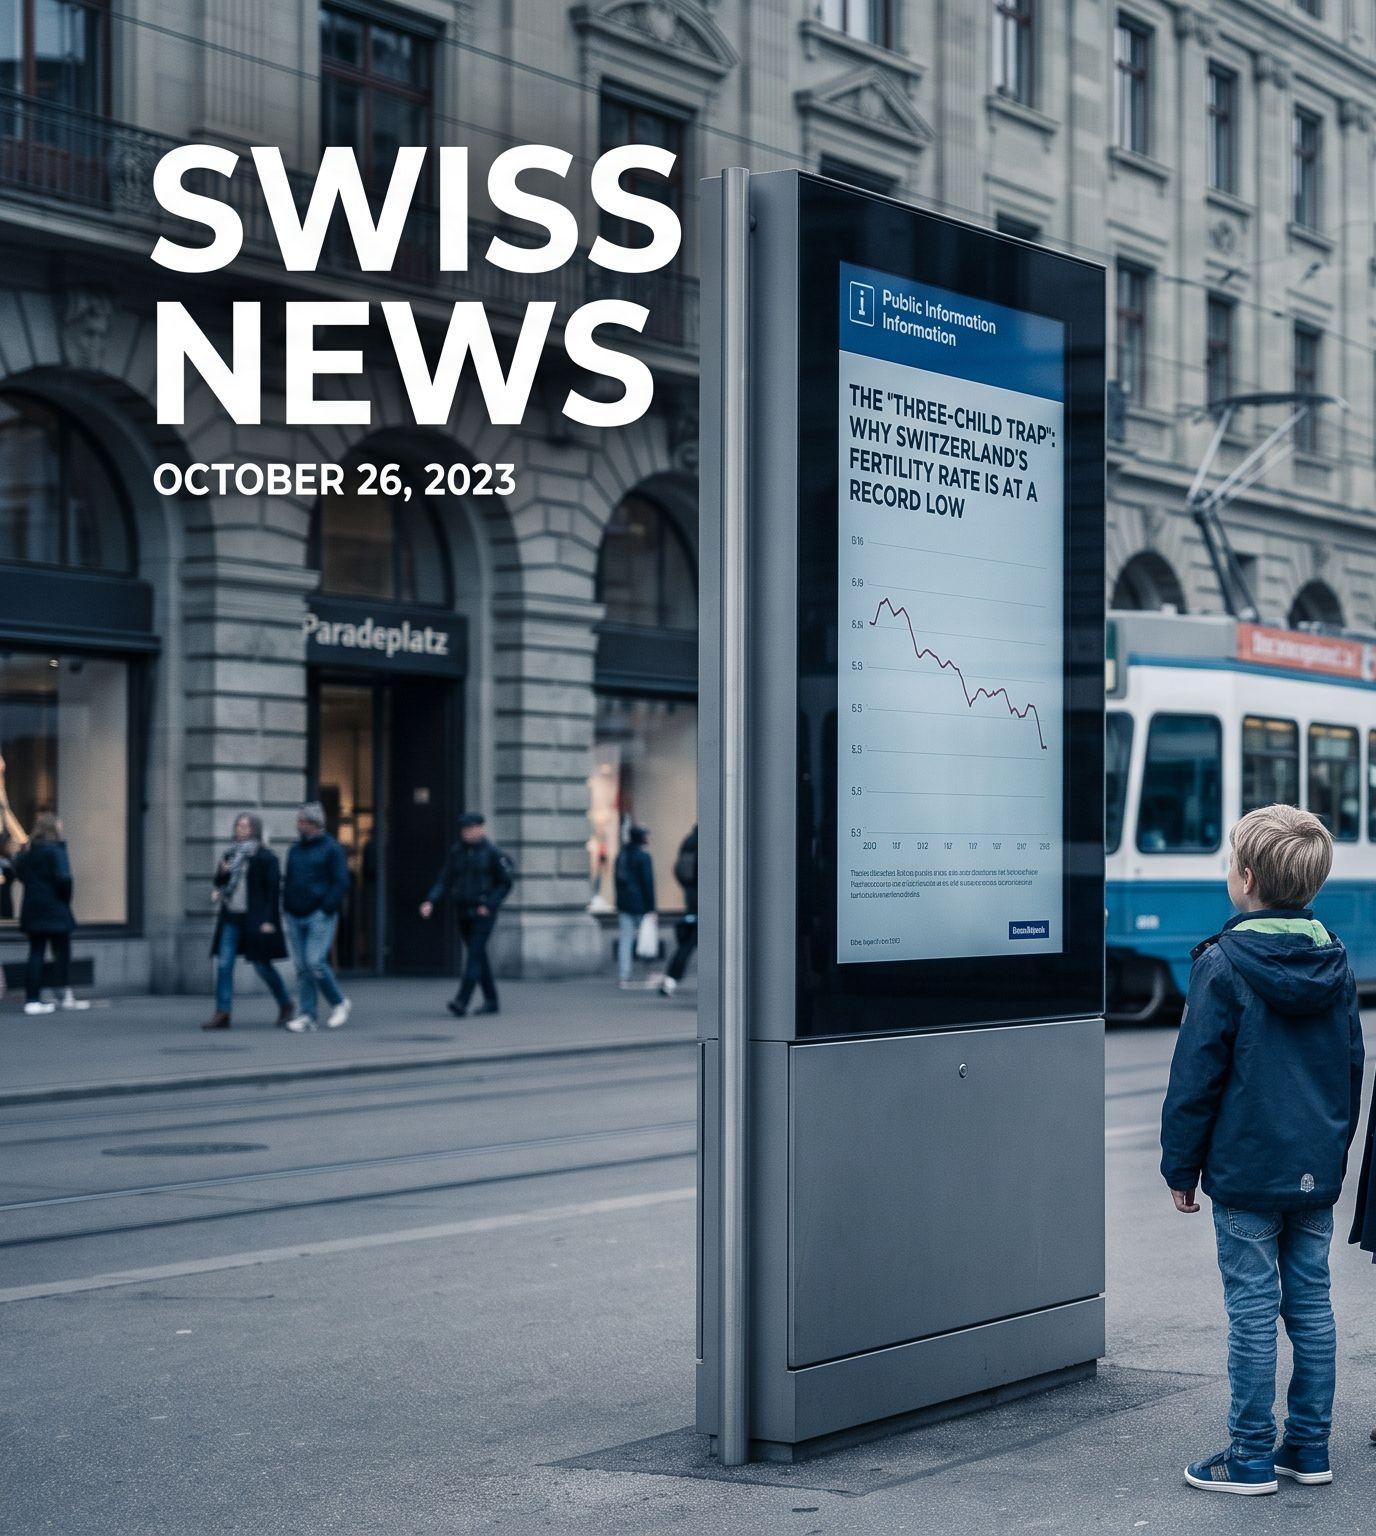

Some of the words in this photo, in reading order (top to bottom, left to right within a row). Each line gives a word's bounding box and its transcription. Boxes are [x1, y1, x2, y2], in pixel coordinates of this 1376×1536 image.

[882, 288, 923, 316] Public
[925, 300, 997, 335] Information
[882, 312, 957, 347] Information
[849, 383, 883, 412] THE
[887, 391, 1002, 436] "THREE-CHILD
[1006, 417, 1056, 448] TRAP":
[849, 415, 892, 444] WHY
[896, 425, 1028, 471] SWITZERLAND'S
[850, 447, 934, 483] FERTILITY
[938, 464, 980, 492] RATE
[985, 472, 999, 495] IS
[1002, 477, 1023, 499] AT
[1026, 481, 1038, 503] A
[850, 478, 921, 511] RECORD
[926, 492, 966, 519] LOW
[302, 611, 449, 658] Paradeplatz
